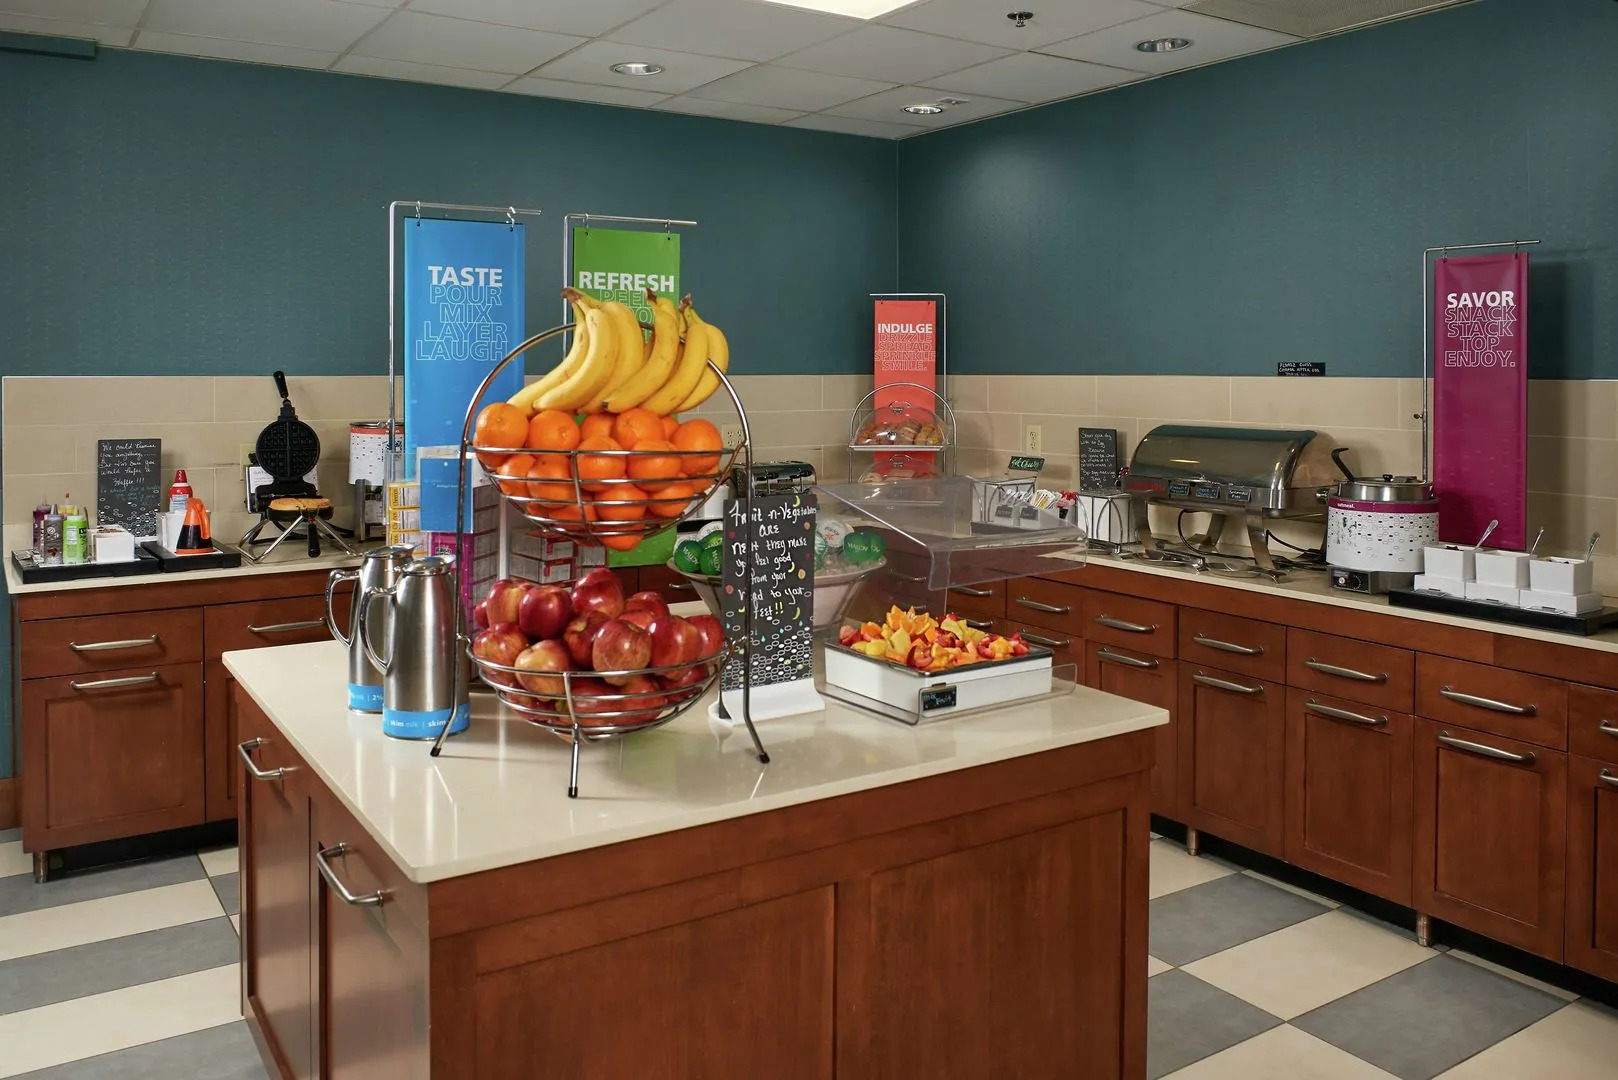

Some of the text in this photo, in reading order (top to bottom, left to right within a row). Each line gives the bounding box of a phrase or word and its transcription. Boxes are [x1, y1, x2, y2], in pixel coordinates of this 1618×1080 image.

[428, 266, 503, 287] TASTE
[579, 271, 675, 292] REFRESH
[430, 284, 502, 305] POUR
[1447, 291, 1515, 308] SAVOR
[440, 303, 493, 323] MIX
[1445, 305, 1517, 322] SNACK
[424, 321, 508, 342] LAYER
[878, 323, 933, 334] INDULGE
[1447, 320, 1514, 337] STACK
[879, 333, 932, 343] DRIZZLE
[879, 341, 931, 352] SPREAD
[1460, 335, 1500, 352] TOP
[874, 350, 936, 362] SPRINKLE
[1445, 350, 1516, 367] ENJOY.
[881, 360, 928, 371] SMILE.
